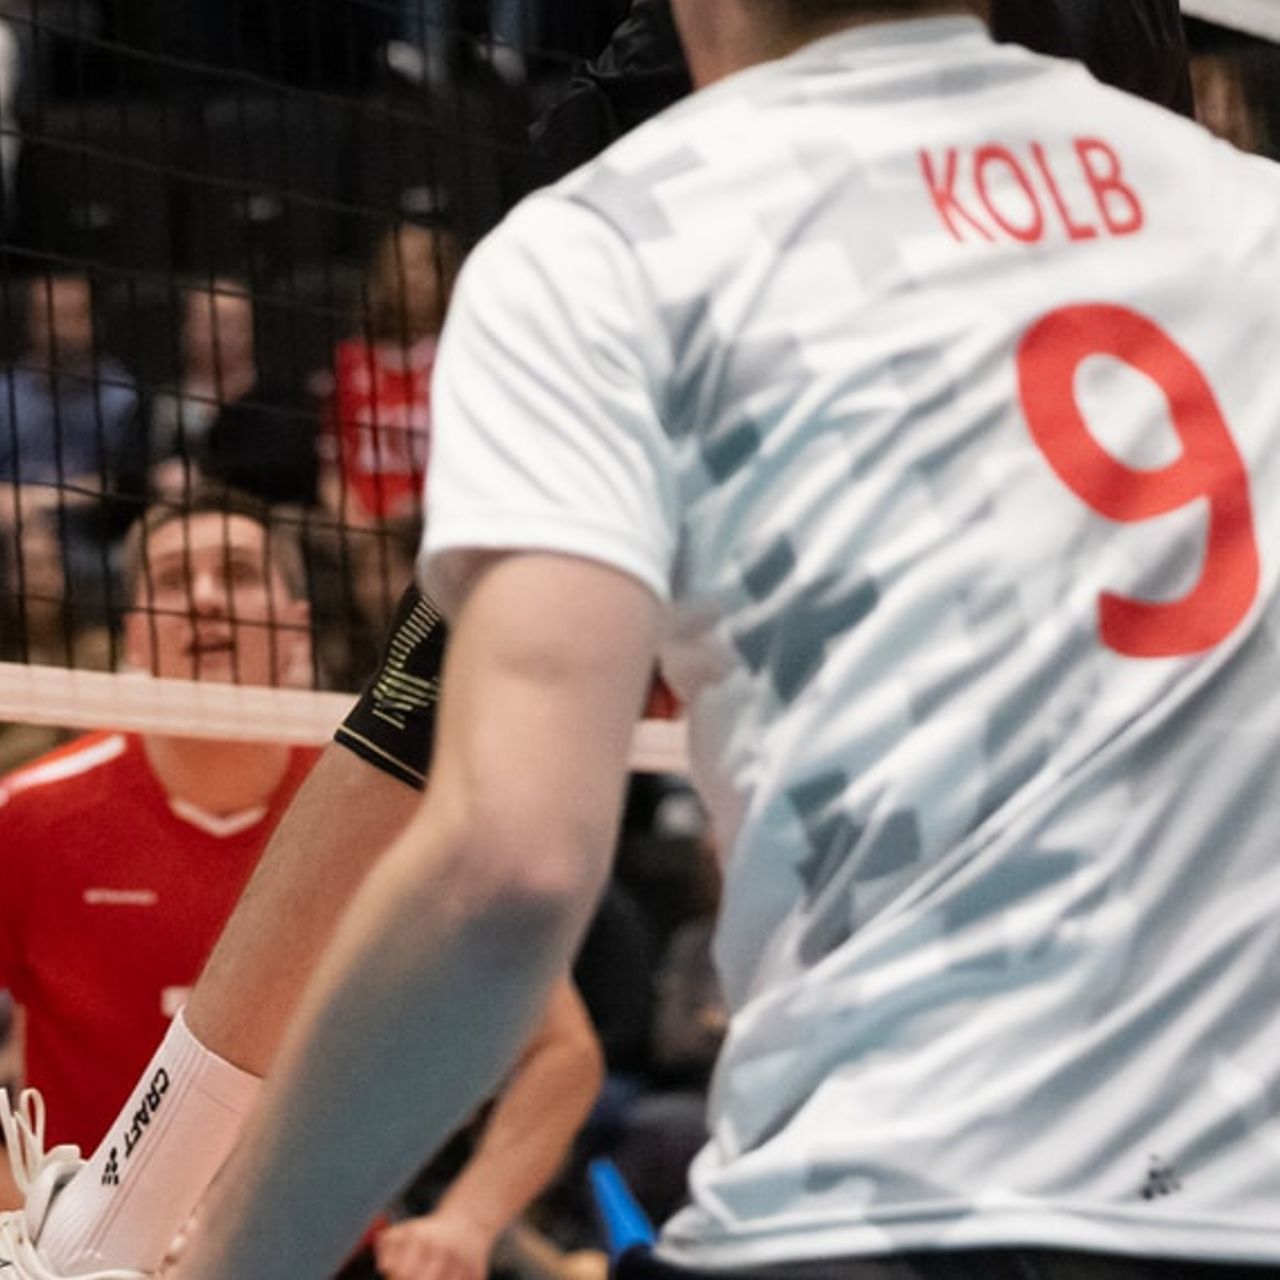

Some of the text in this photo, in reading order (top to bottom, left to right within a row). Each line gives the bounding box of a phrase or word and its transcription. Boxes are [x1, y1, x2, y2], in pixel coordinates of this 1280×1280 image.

[920, 137, 1144, 244] KOLB
[1015, 301, 1261, 660] 9
[124, 1067, 170, 1159] CRAFT
